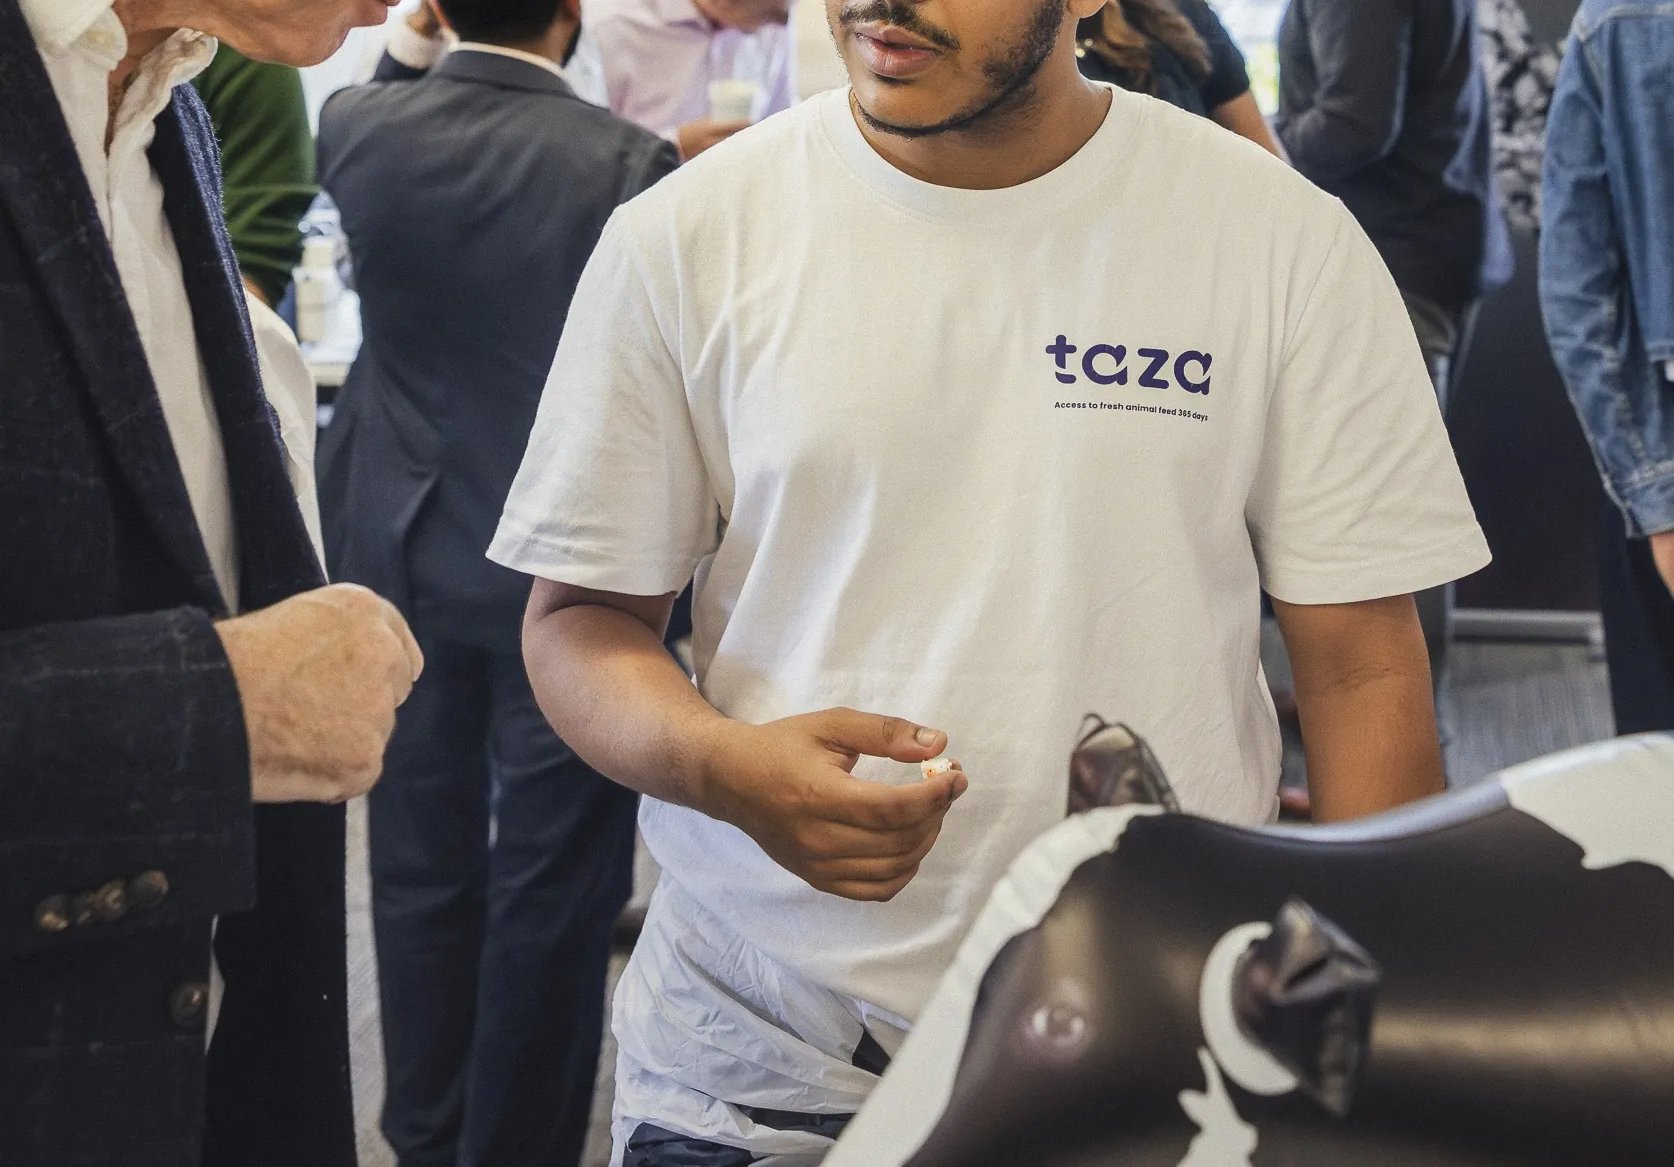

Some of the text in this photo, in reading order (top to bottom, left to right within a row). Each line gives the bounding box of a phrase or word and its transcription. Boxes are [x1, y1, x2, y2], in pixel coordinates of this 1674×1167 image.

[1045, 334, 1213, 396] taza
[1054, 401, 1087, 409] Access
[1100, 401, 1124, 411] fresh
[1125, 403, 1157, 414] animal
[1158, 405, 1177, 416] feed
[1178, 409, 1191, 418] 365
[1192, 411, 1208, 423] days
